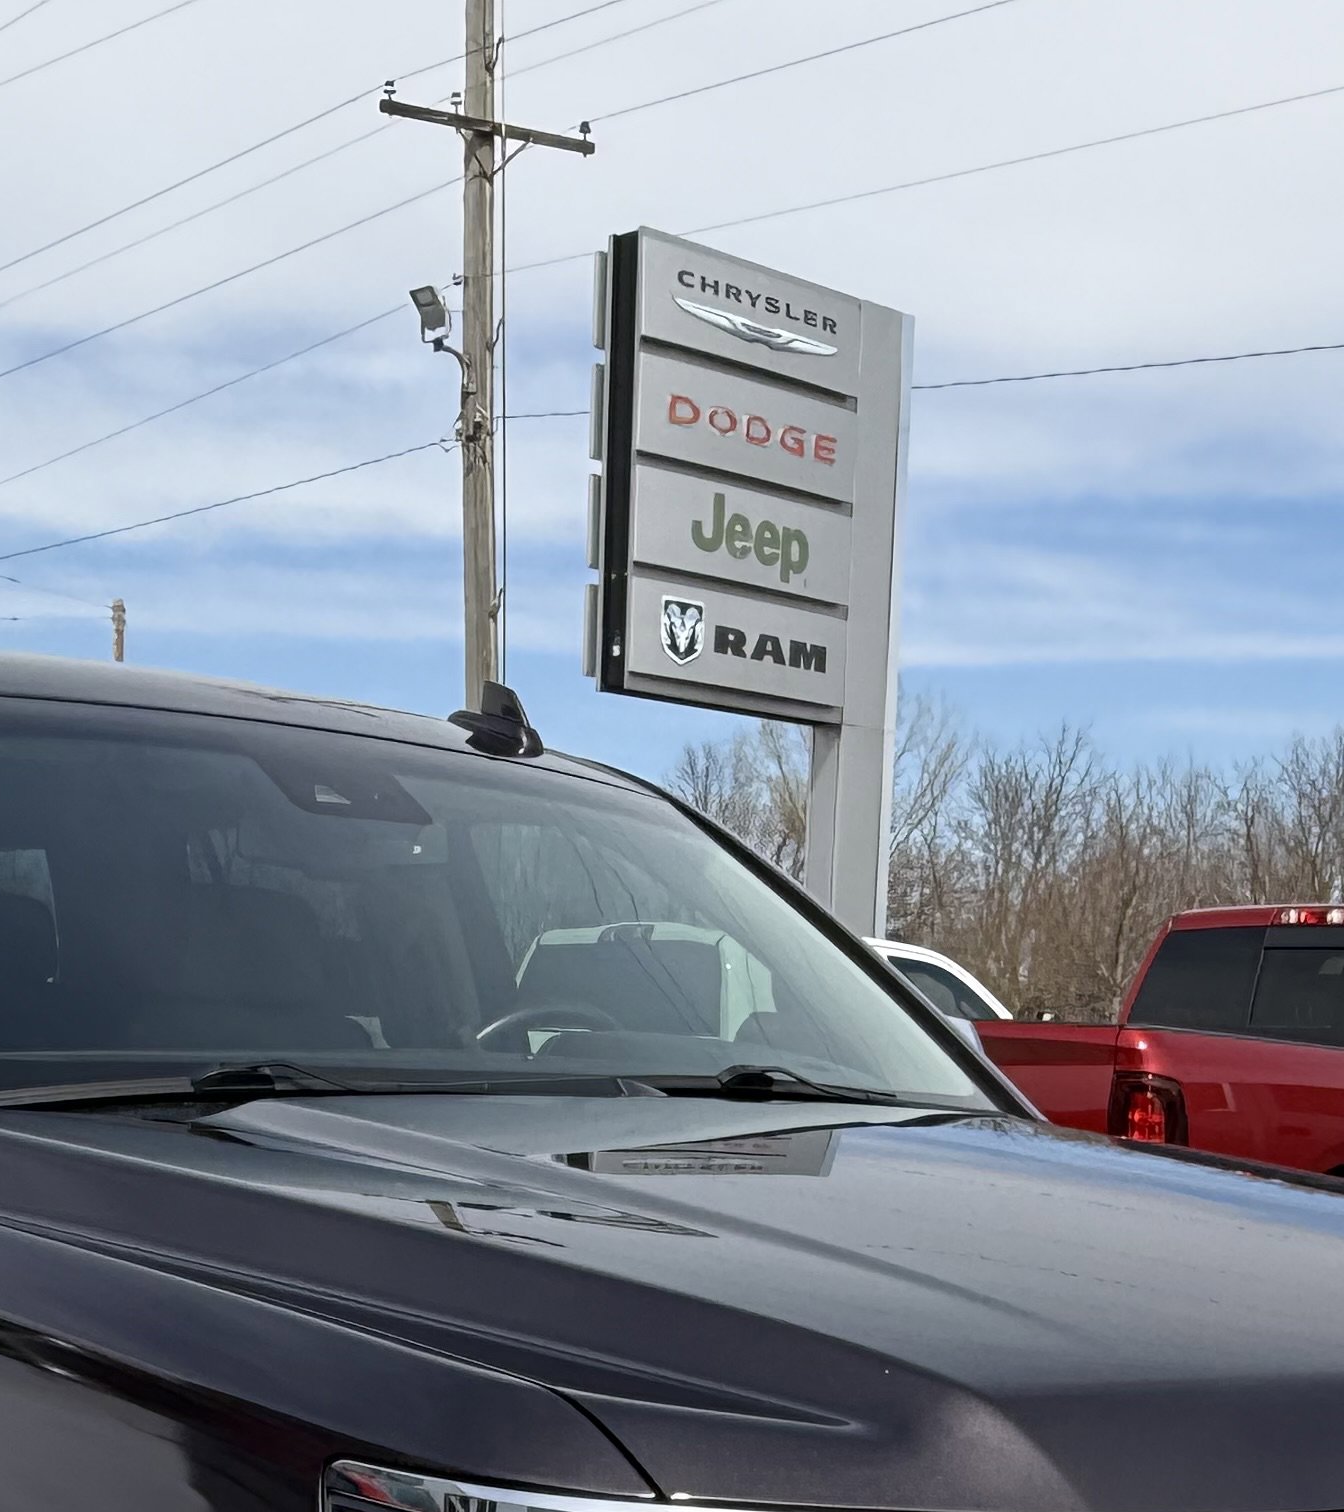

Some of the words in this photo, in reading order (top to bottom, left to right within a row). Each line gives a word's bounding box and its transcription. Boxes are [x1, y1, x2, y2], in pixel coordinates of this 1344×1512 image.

[677, 270, 837, 335] CHRYSLER
[668, 394, 837, 465] DODGE
[691, 493, 809, 582] Jeep
[713, 625, 827, 674] RAM
